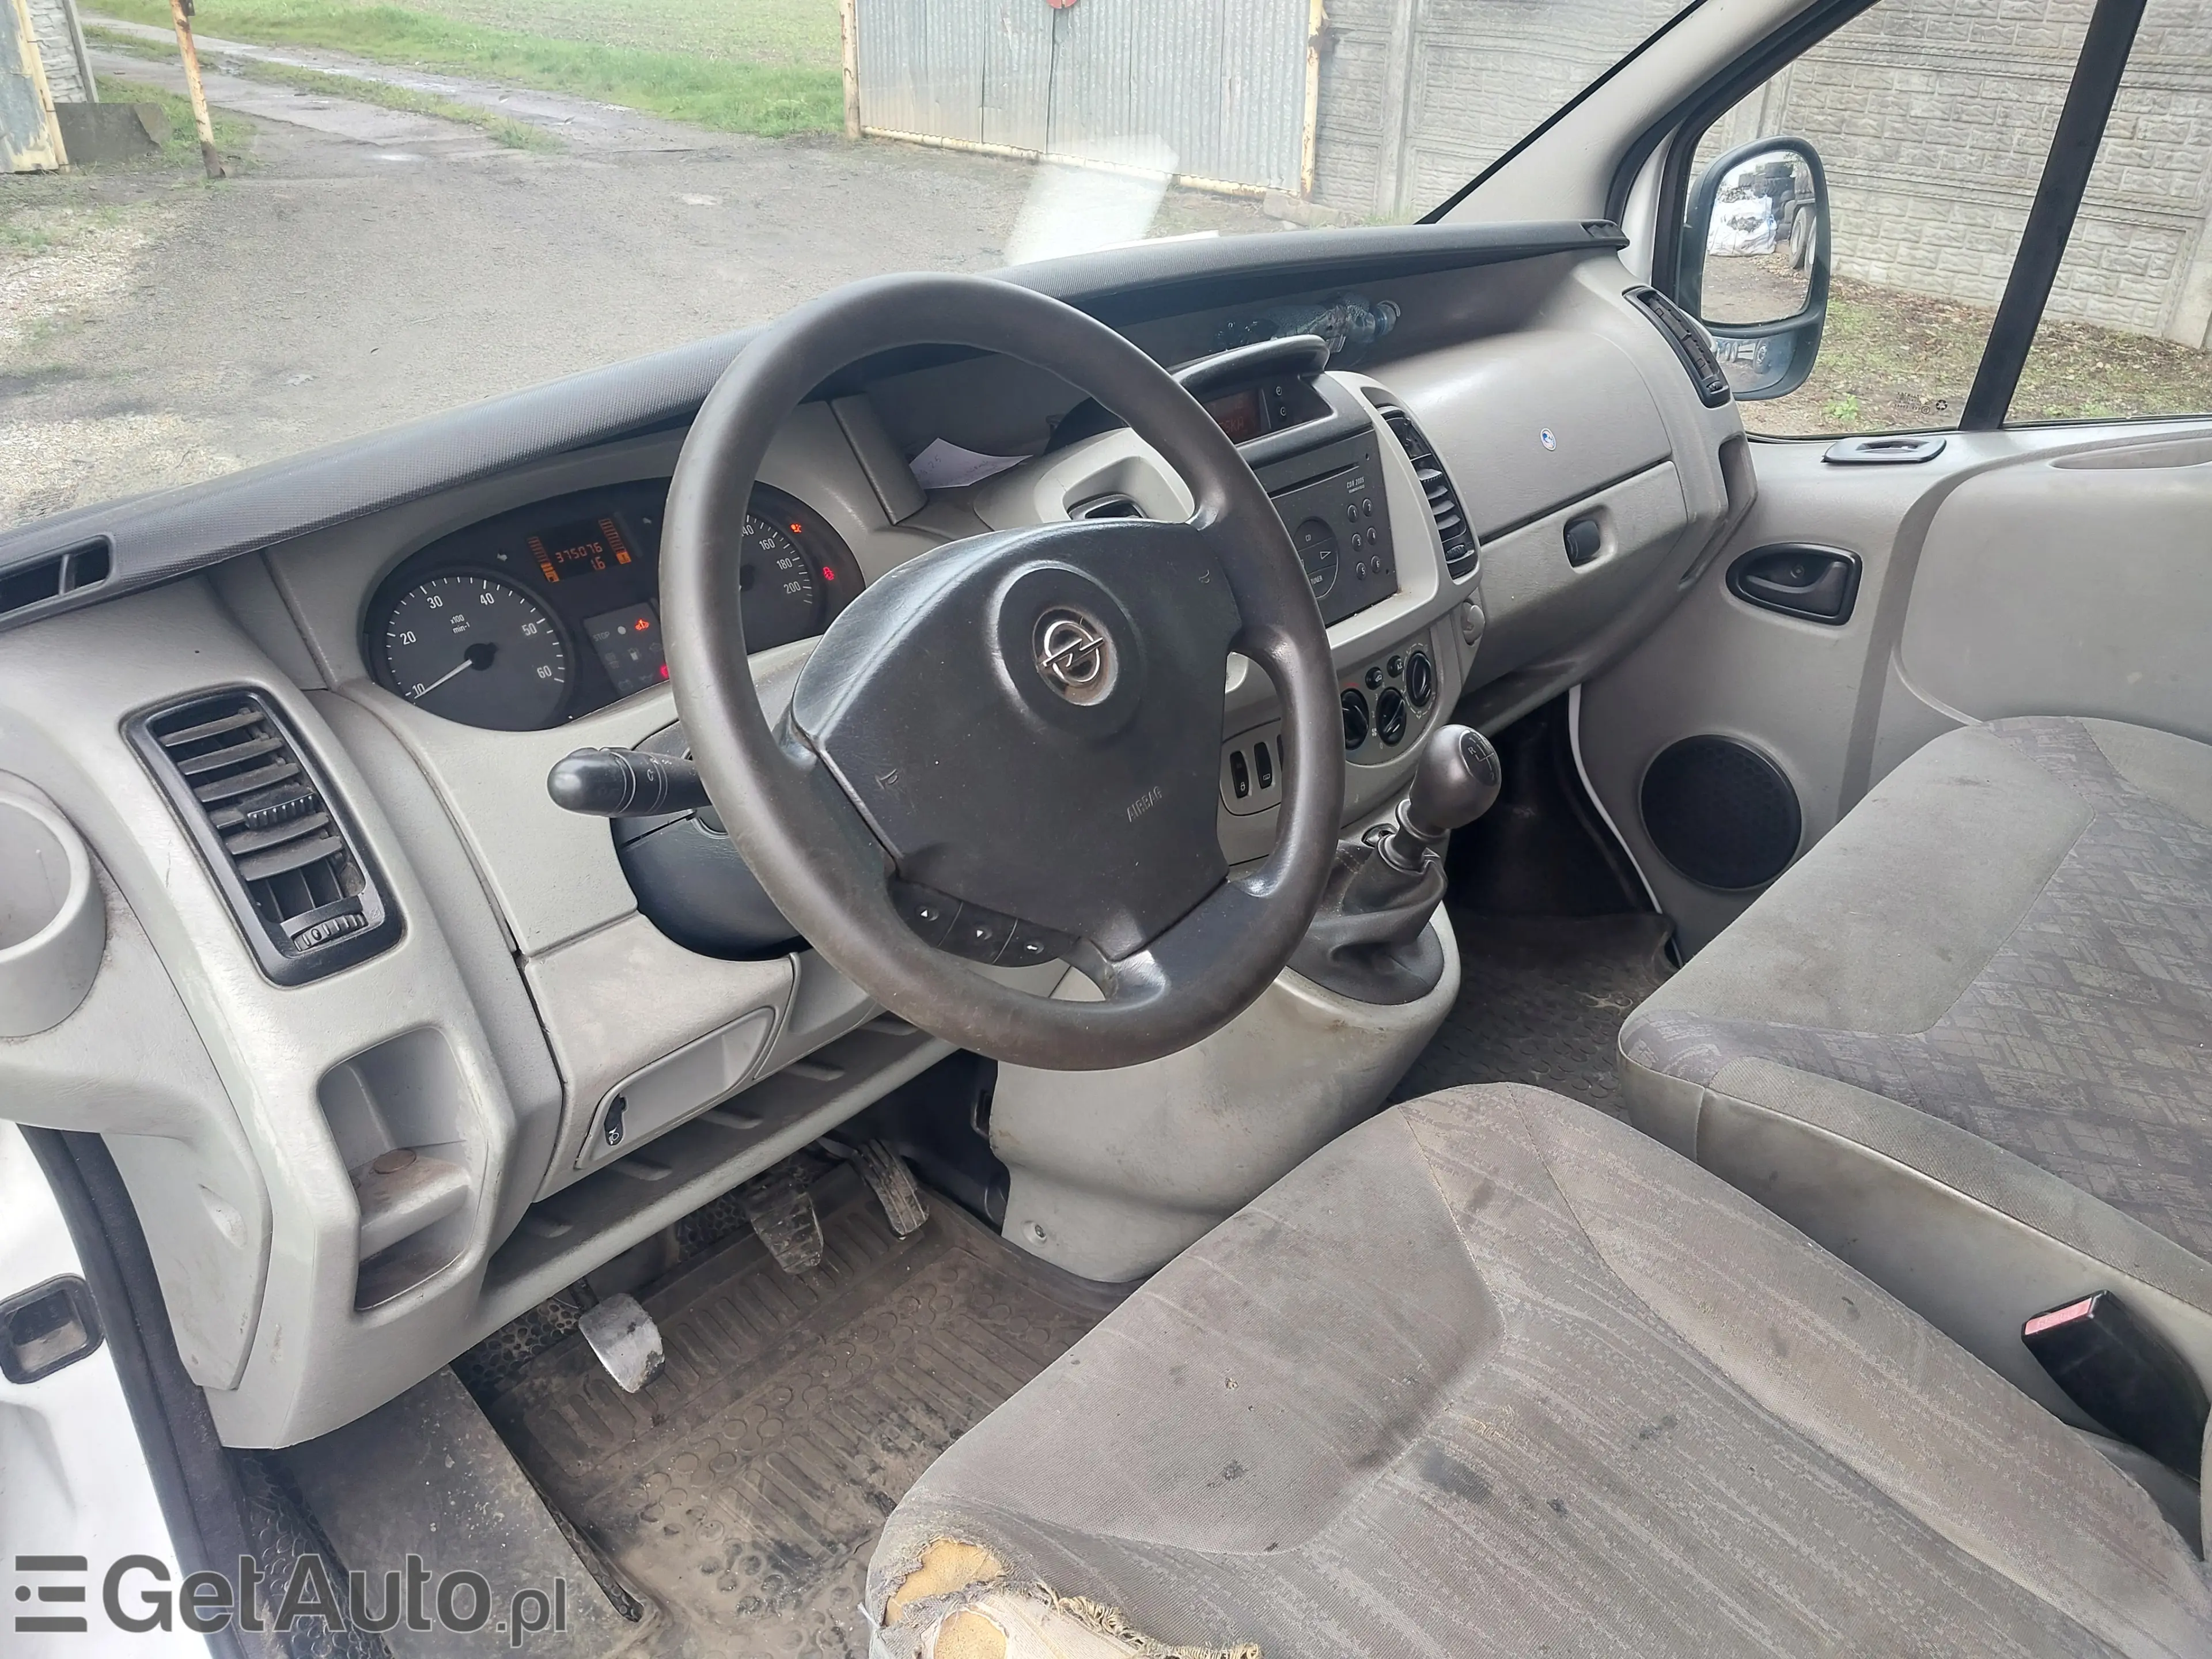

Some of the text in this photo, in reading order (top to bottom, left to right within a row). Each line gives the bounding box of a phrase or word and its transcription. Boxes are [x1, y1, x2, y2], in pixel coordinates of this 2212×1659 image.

[742, 525, 754, 536] 40
[759, 538, 775, 550] 160
[555, 542, 603, 563] 375076
[776, 558, 793, 570] 180
[1310, 575, 1323, 585] TUNER
[783, 581, 801, 594] 200
[426, 595, 443, 609] 30
[480, 592, 495, 605] 40
[450, 613, 465, 624] x100
[452, 622, 471, 634] min-1
[521, 623, 537, 637] 50
[400, 631, 416, 645] 20
[593, 631, 610, 642] STOP
[537, 665, 552, 679] 60
[412, 683, 426, 695] 10
[1468, 747, 1476, 755] R
[1127, 786, 1162, 823] AIRBAG
